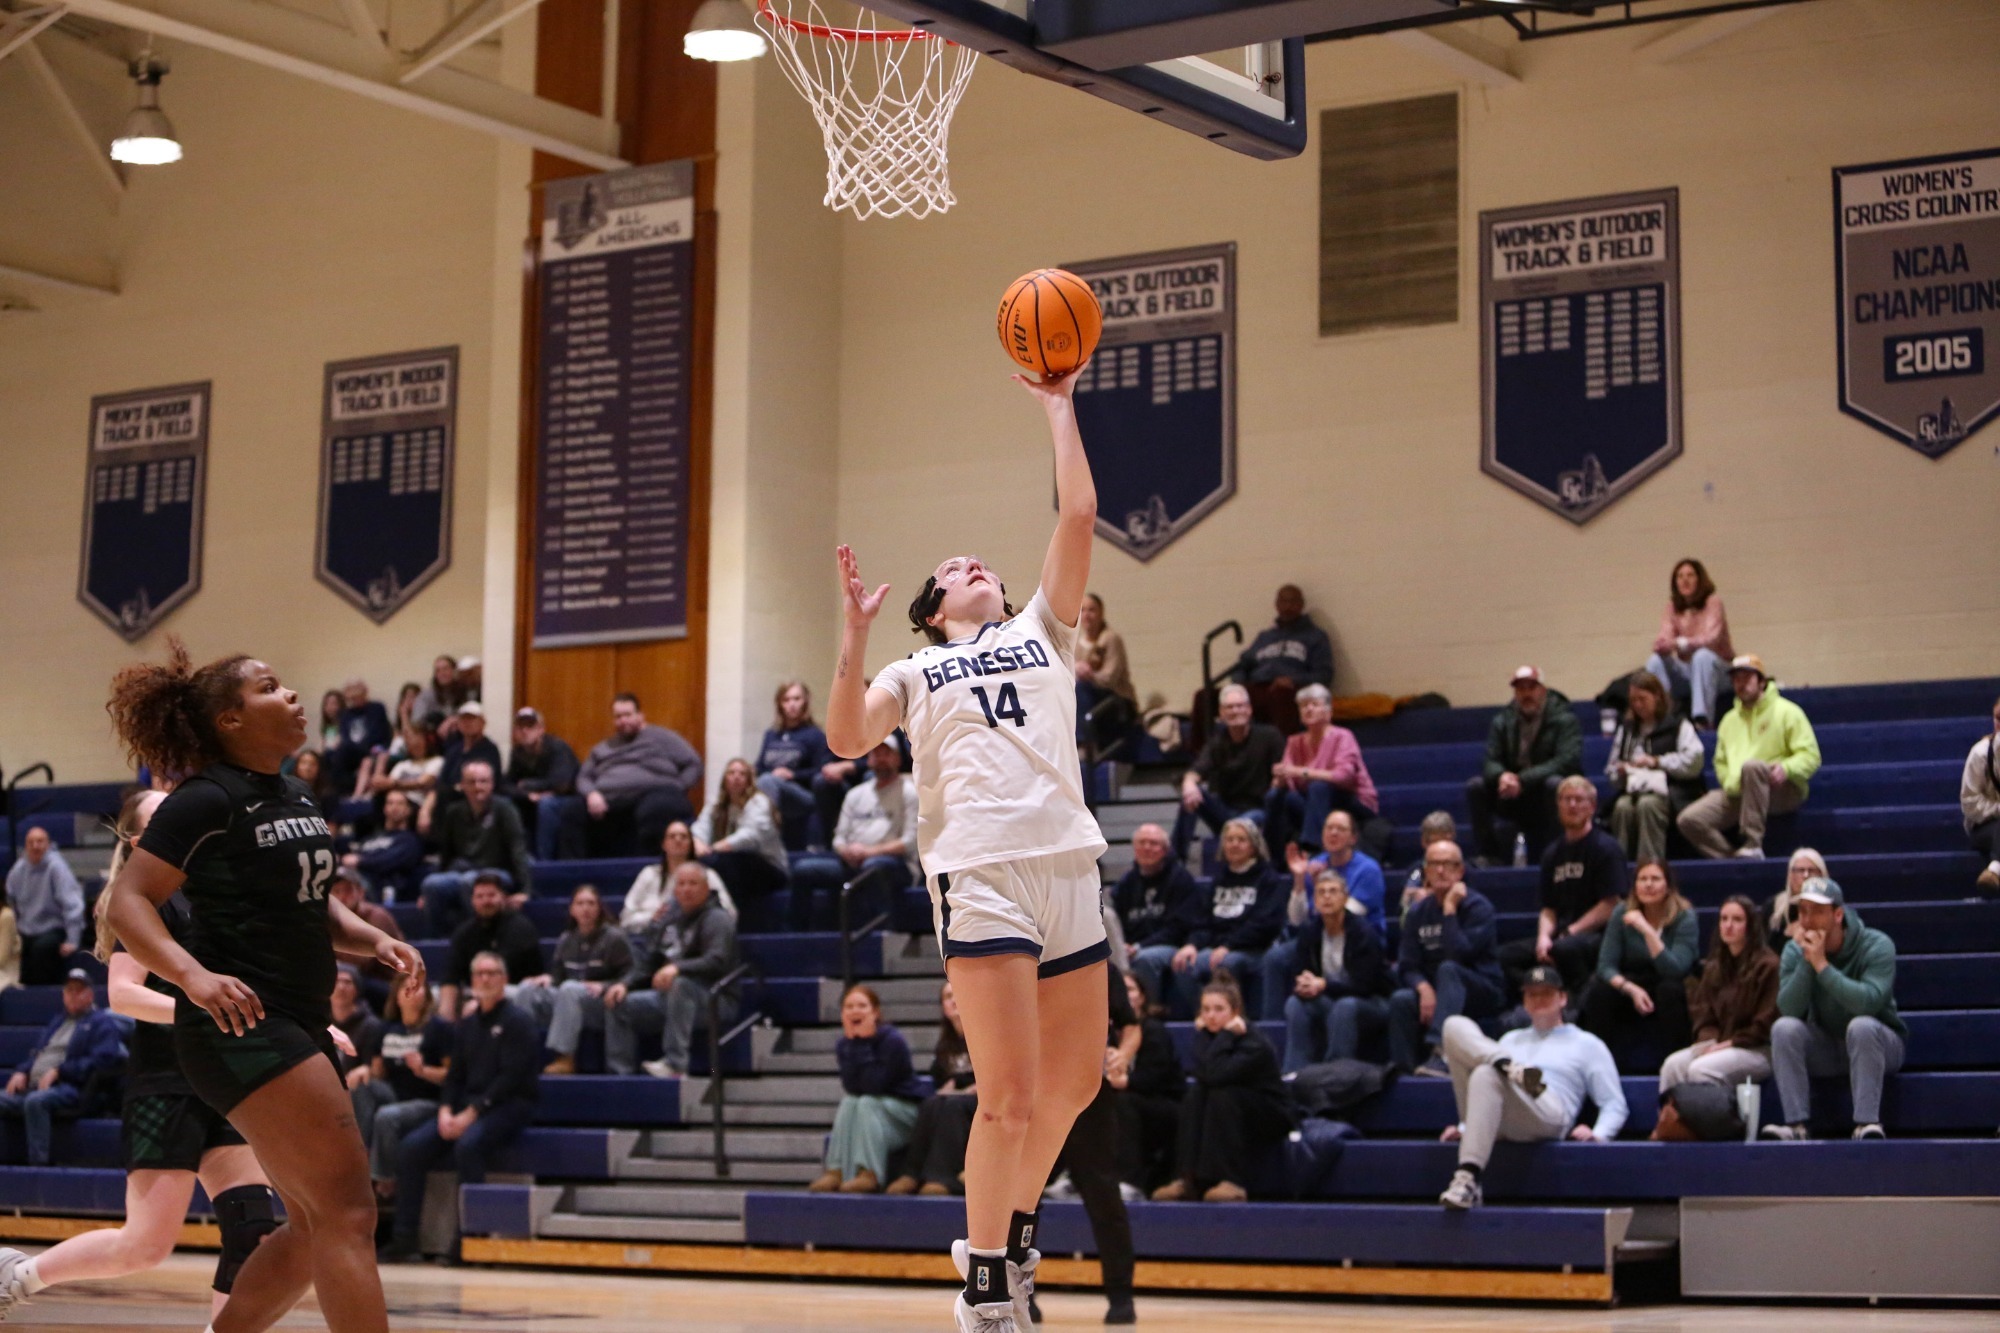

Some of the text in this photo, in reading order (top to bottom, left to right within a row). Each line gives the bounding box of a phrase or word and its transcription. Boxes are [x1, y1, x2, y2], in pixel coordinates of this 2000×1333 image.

[1883, 166, 1973, 197] WOMEN'S
[1845, 189, 2000, 228] CROSS COUNTR
[597, 220, 681, 246] AMERICANS
[1495, 209, 1661, 249] WOMEN'S OUTDOOR
[1504, 246, 1570, 272] TRACK
[1599, 236, 1654, 262] FIELD
[1892, 243, 1970, 280] NCAA
[1090, 263, 1219, 298] EN'S OUTDOOR
[1102, 298, 1139, 319] ACK
[1165, 288, 1214, 312] FIELD
[1895, 336, 1972, 375] 2005
[336, 364, 445, 393] WOMEN'S INDOOR
[105, 405, 144, 423] MEN'S
[341, 393, 383, 414] TRACK
[403, 385, 440, 406] FIELD
[103, 425, 141, 443] TRACK
[158, 417, 192, 436] FIELD
[922, 639, 1050, 694] GENESEO
[970, 681, 1028, 729] 14
[296, 848, 334, 903] 12
